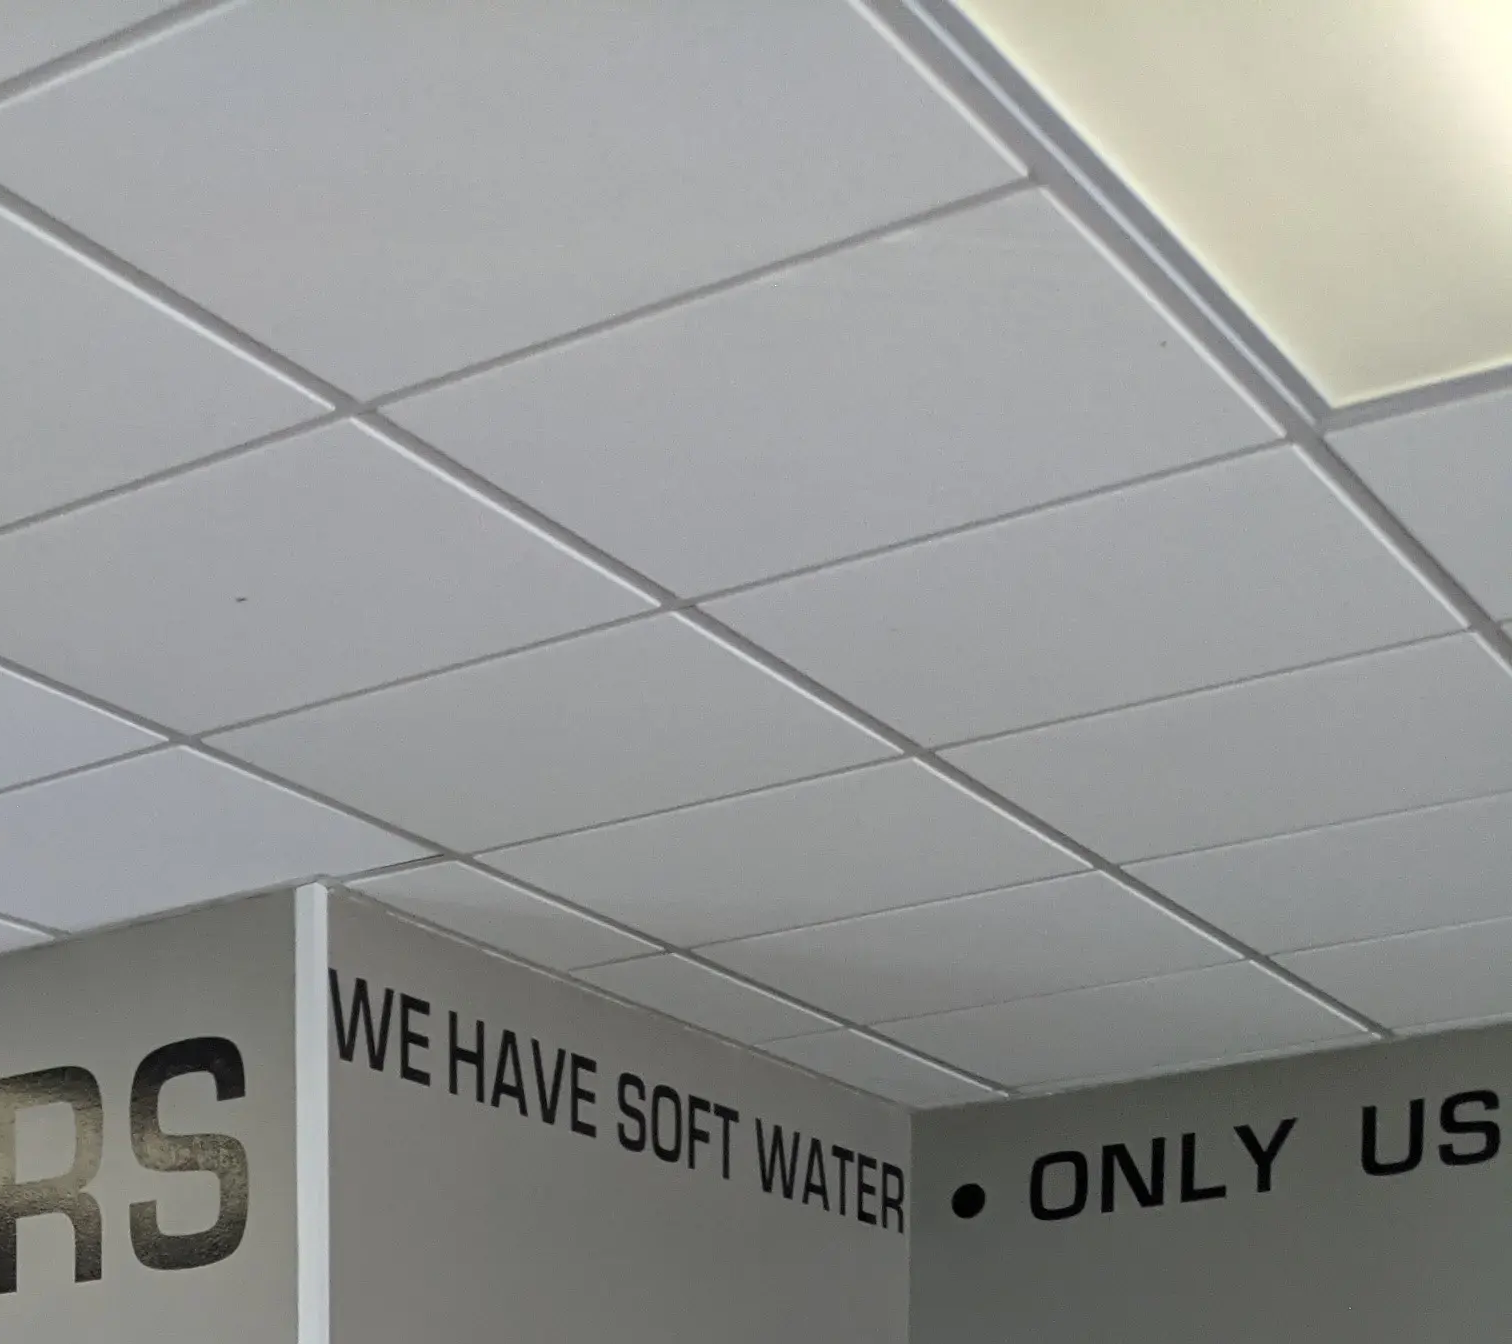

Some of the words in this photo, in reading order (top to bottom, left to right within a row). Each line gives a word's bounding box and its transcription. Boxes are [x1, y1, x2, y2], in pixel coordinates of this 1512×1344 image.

[328, 967, 431, 1087] WE
[448, 1010, 597, 1139] HAVE
[617, 1072, 740, 1181] SOFT
[754, 1117, 904, 1235] WATER
[1028, 1116, 1299, 1222] ONLY
